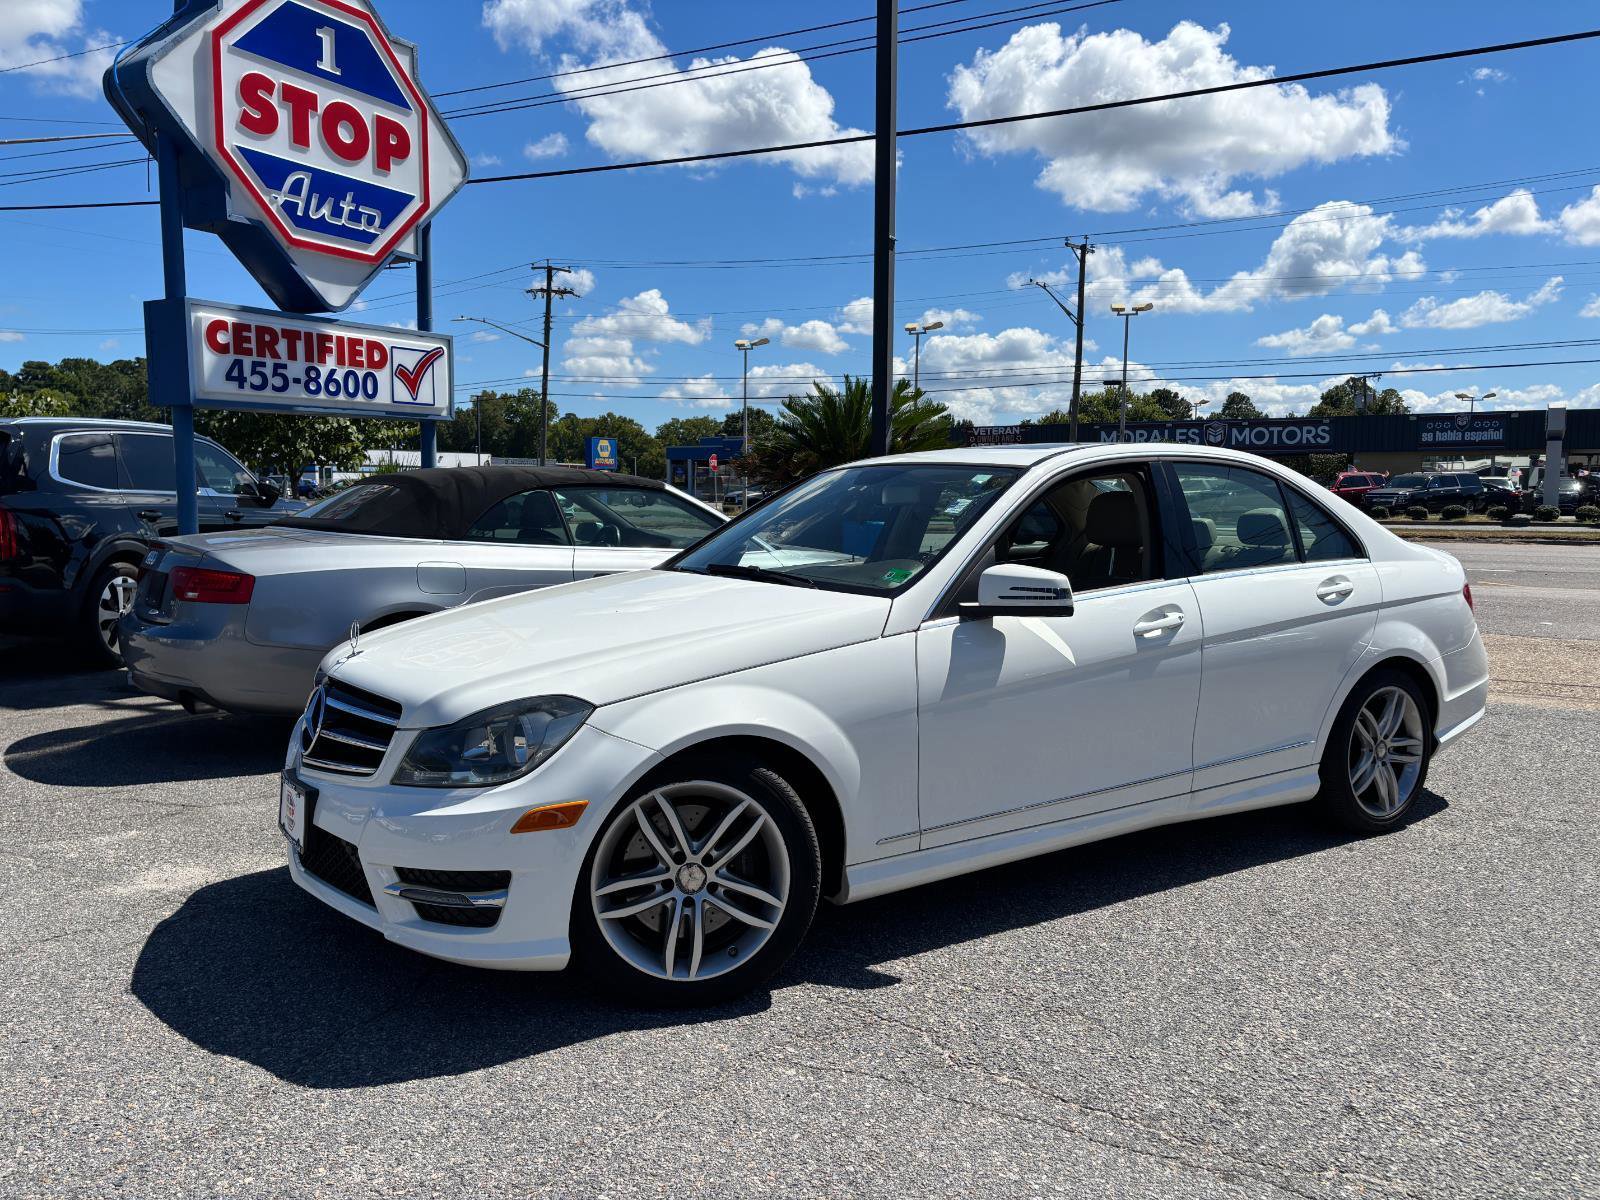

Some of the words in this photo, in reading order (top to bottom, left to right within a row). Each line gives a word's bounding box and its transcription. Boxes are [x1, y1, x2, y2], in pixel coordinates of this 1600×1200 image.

[315, 26, 342, 76] 1
[239, 72, 412, 173] STOP
[269, 170, 386, 235] Auto
[205, 318, 389, 371] CERTIFIED
[225, 357, 379, 400] 455-8600
[972, 426, 1020, 435] VETERAN
[1100, 428, 1200, 444] MORALES
[1231, 426, 1330, 446] MOTORS
[1421, 432, 1434, 442] se
[1435, 429, 1462, 442] habla
[1464, 428, 1504, 443] español
